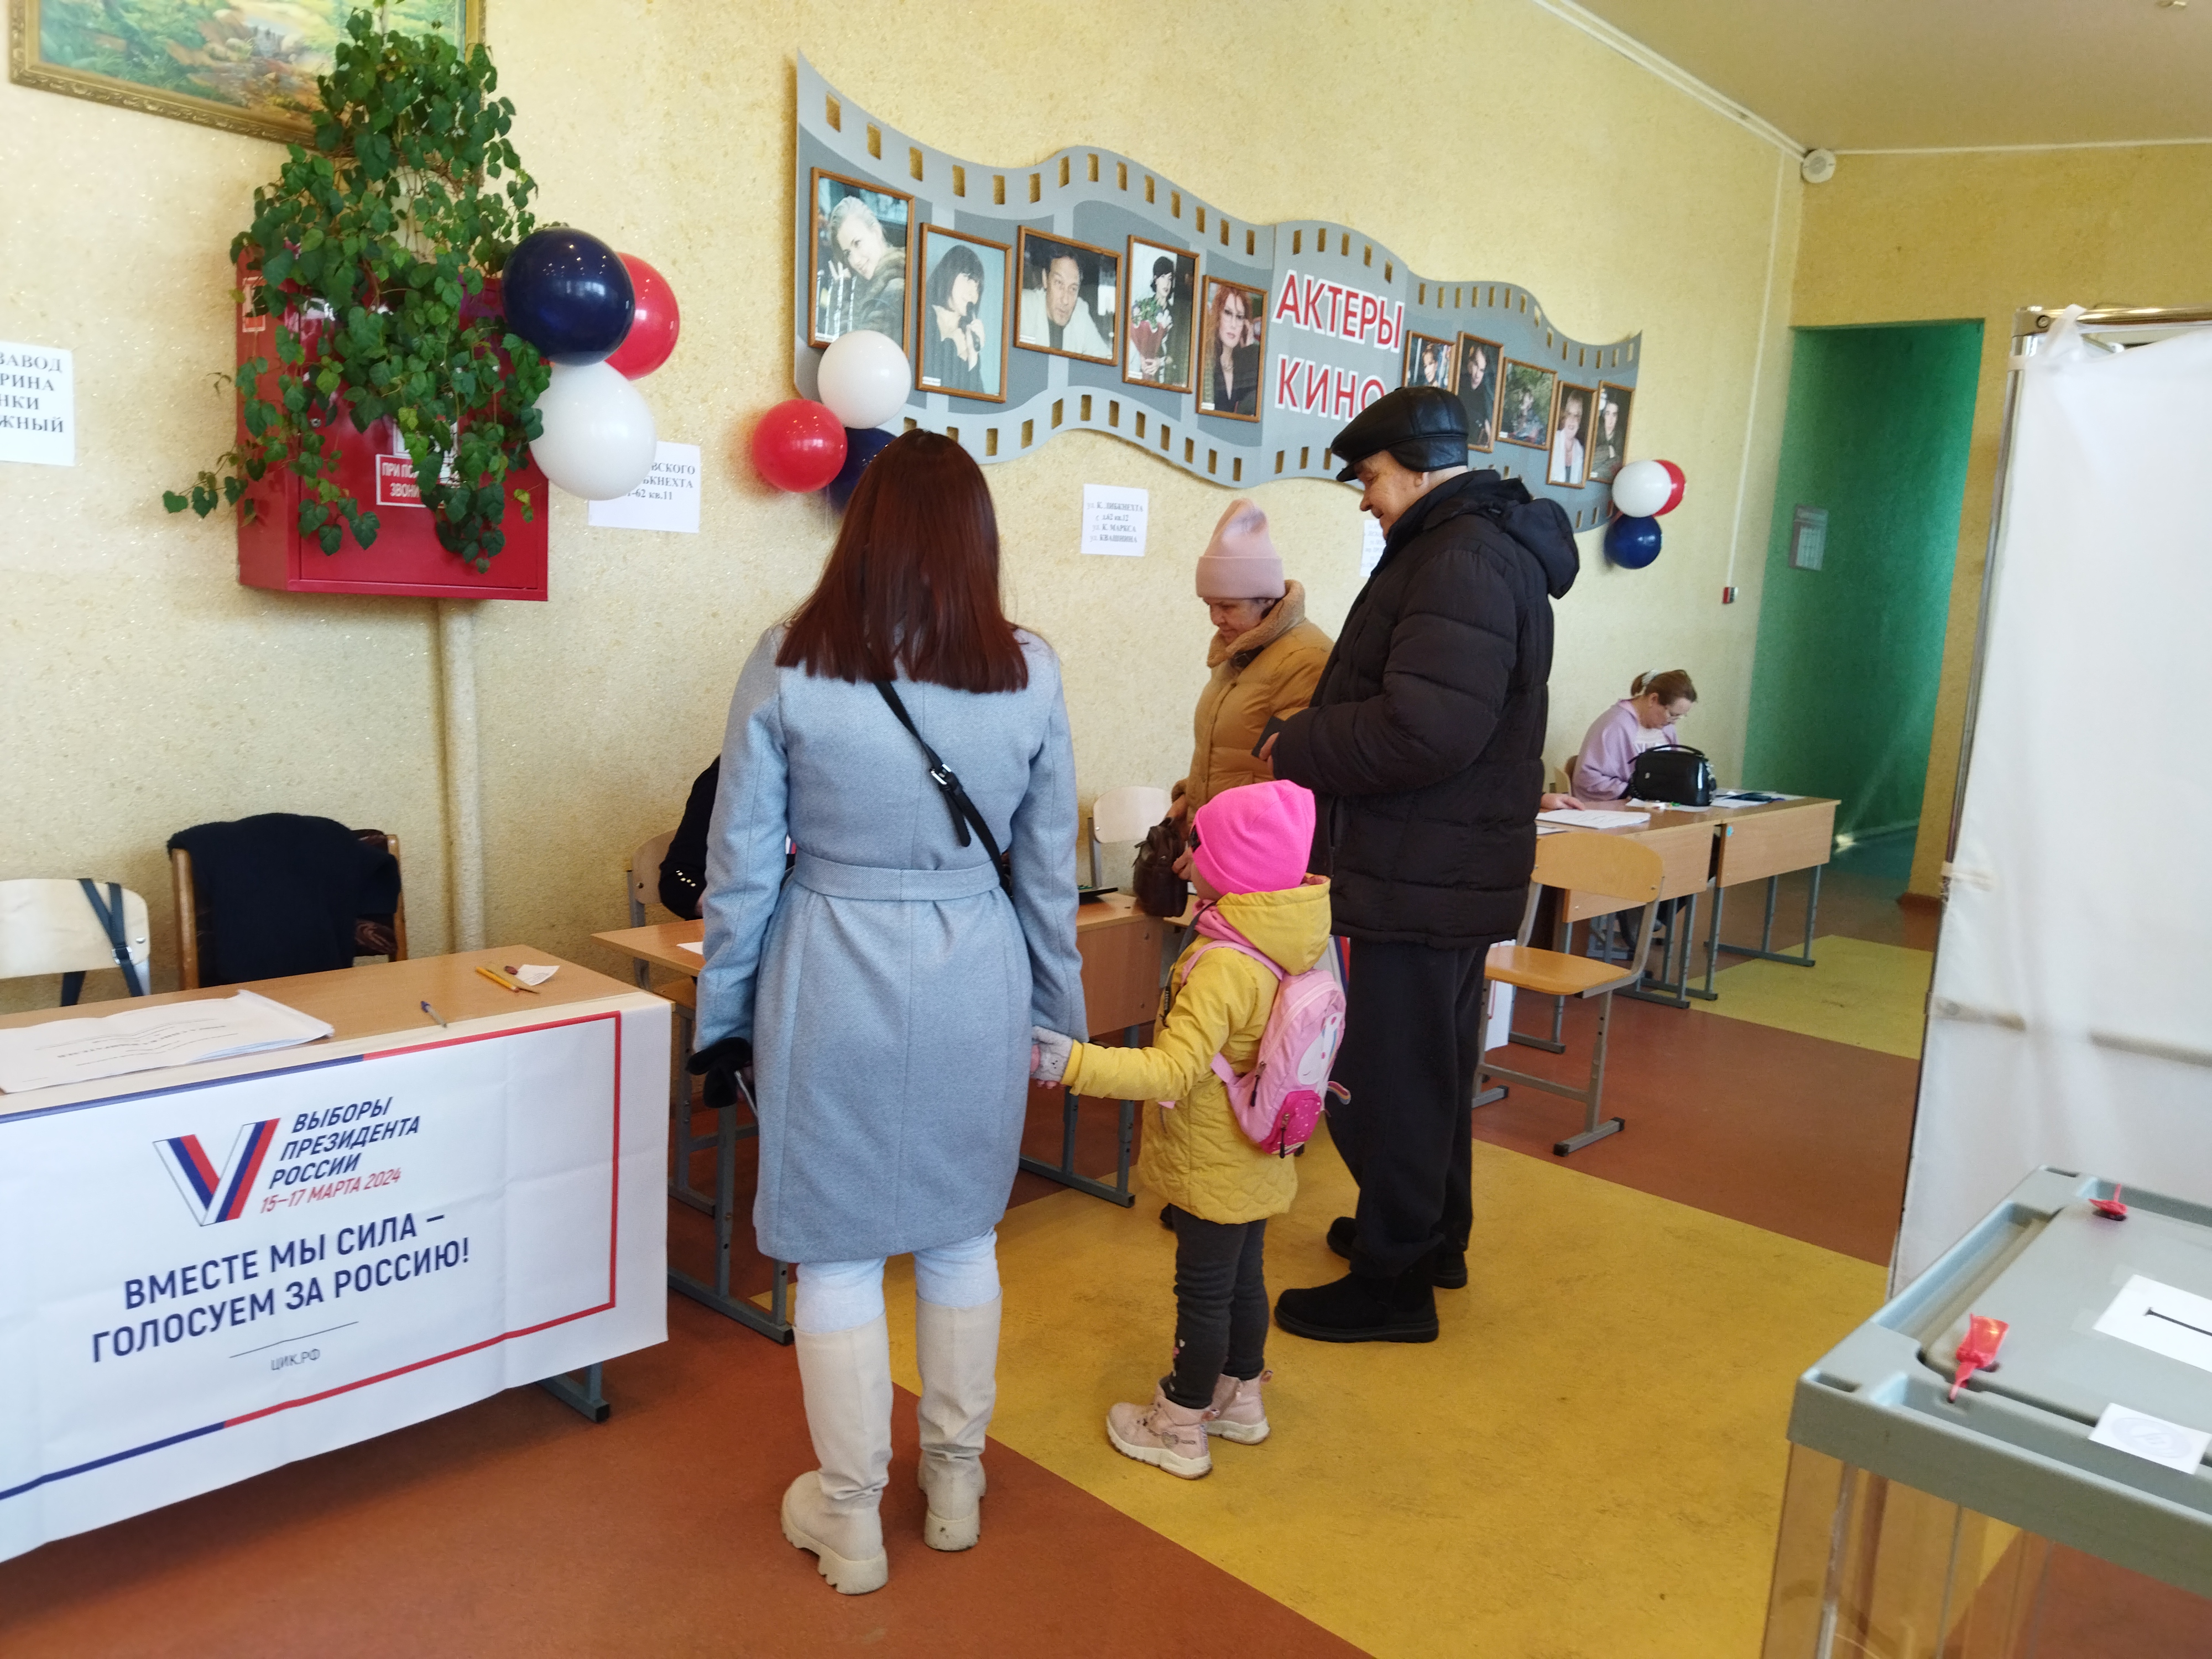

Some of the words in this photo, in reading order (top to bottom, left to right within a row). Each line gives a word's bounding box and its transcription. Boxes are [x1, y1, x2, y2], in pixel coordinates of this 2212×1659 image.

[1272, 270, 1404, 353] АКТЕРЫ
[0, 373, 54, 391] РИНА
[1275, 354, 1387, 422] КИНО
[0, 394, 39, 410] НКИ
[0, 415, 64, 432] ЖНЫЙ
[382, 462, 400, 477] ПРИ
[651, 462, 696, 474] ВСКОГО
[649, 491, 672, 500] кв.11
[291, 1097, 393, 1134] ВЫБОРЫ
[280, 1115, 420, 1161] ПРЕЗИДЕНТА
[268, 1152, 362, 1190] РОССИИ
[307, 1176, 362, 1203] МАРТА
[363, 1167, 401, 1190] 2024
[124, 1249, 259, 1310] ВМЕСТЕ
[270, 1234, 325, 1272] МЫ
[337, 1213, 418, 1255] СИЛА
[92, 1288, 275, 1363] ГОЛОСУЕМ
[285, 1277, 325, 1310] ЗА
[335, 1237, 469, 1298] РОССИЮ!
